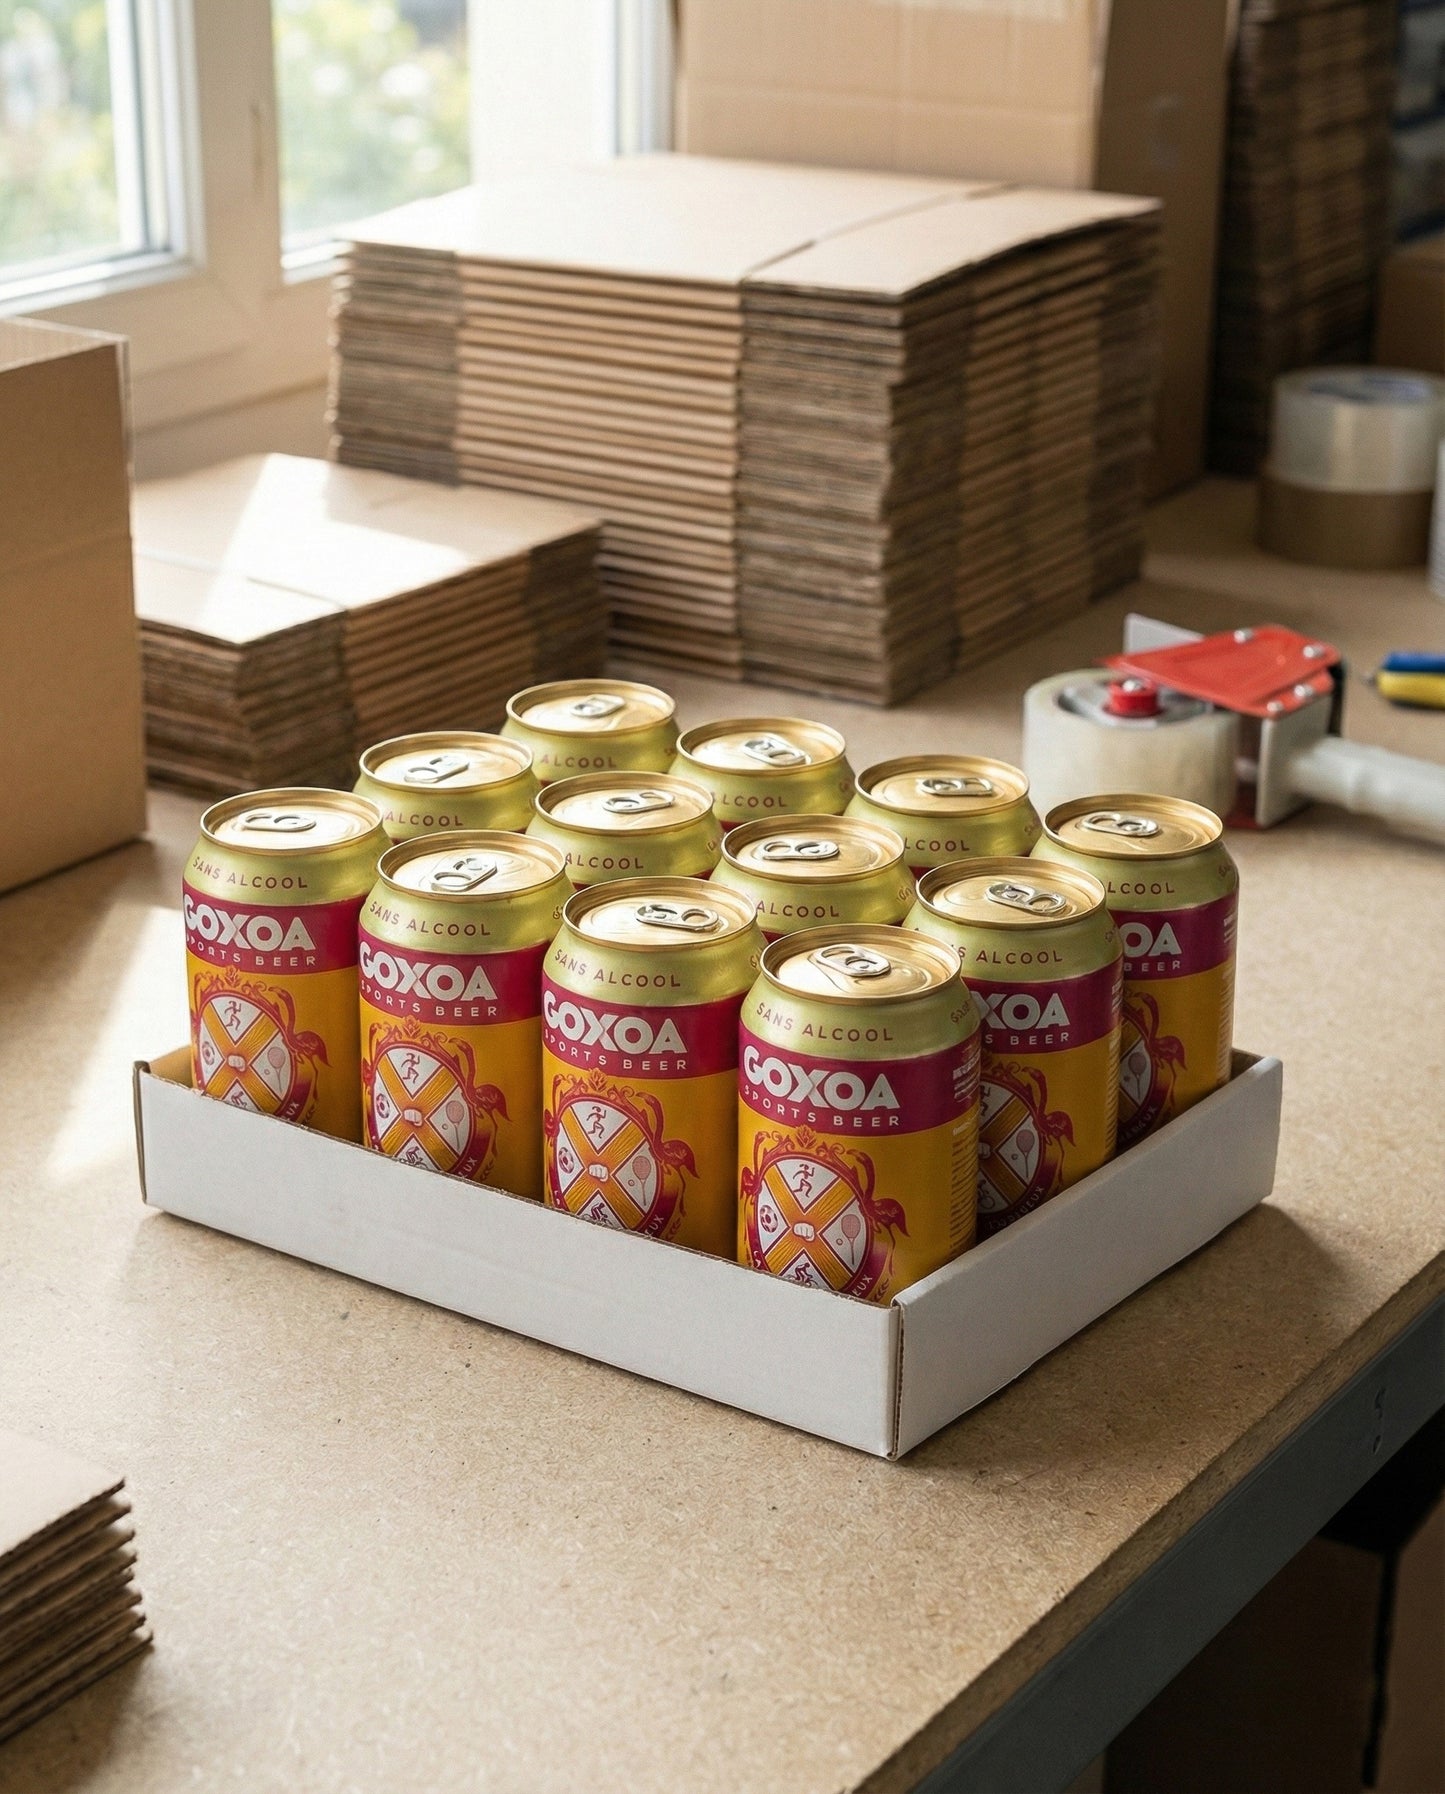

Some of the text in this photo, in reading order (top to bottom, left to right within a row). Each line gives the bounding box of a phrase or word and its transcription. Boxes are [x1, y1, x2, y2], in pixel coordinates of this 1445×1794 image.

[540, 754, 617, 769] ALCOOL
[385, 810, 463, 827] ALCOOL
[192, 856, 308, 889] SANS ALCOOL
[565, 852, 644, 870] ALCOOL
[184, 893, 316, 952] GOXOA
[369, 900, 491, 936] SANS ALCOOL
[755, 900, 840, 919] ALCOOL
[255, 955, 316, 967] BEER
[359, 940, 498, 1002] GOXOA
[554, 949, 681, 988] SANS ALCOOL
[975, 949, 1063, 965] ALCOOL
[1124, 960, 1181, 973] BEER
[361, 979, 497, 1017] SPORTS BEER
[543, 989, 688, 1055] GOXOA
[756, 1001, 894, 1042] SANS ALCOOL
[1010, 1032, 1069, 1046] BEER
[545, 1028, 688, 1071] SPORTS BEER
[743, 1045, 901, 1111] GOXOA
[744, 1084, 899, 1127] SPORTS BEER
